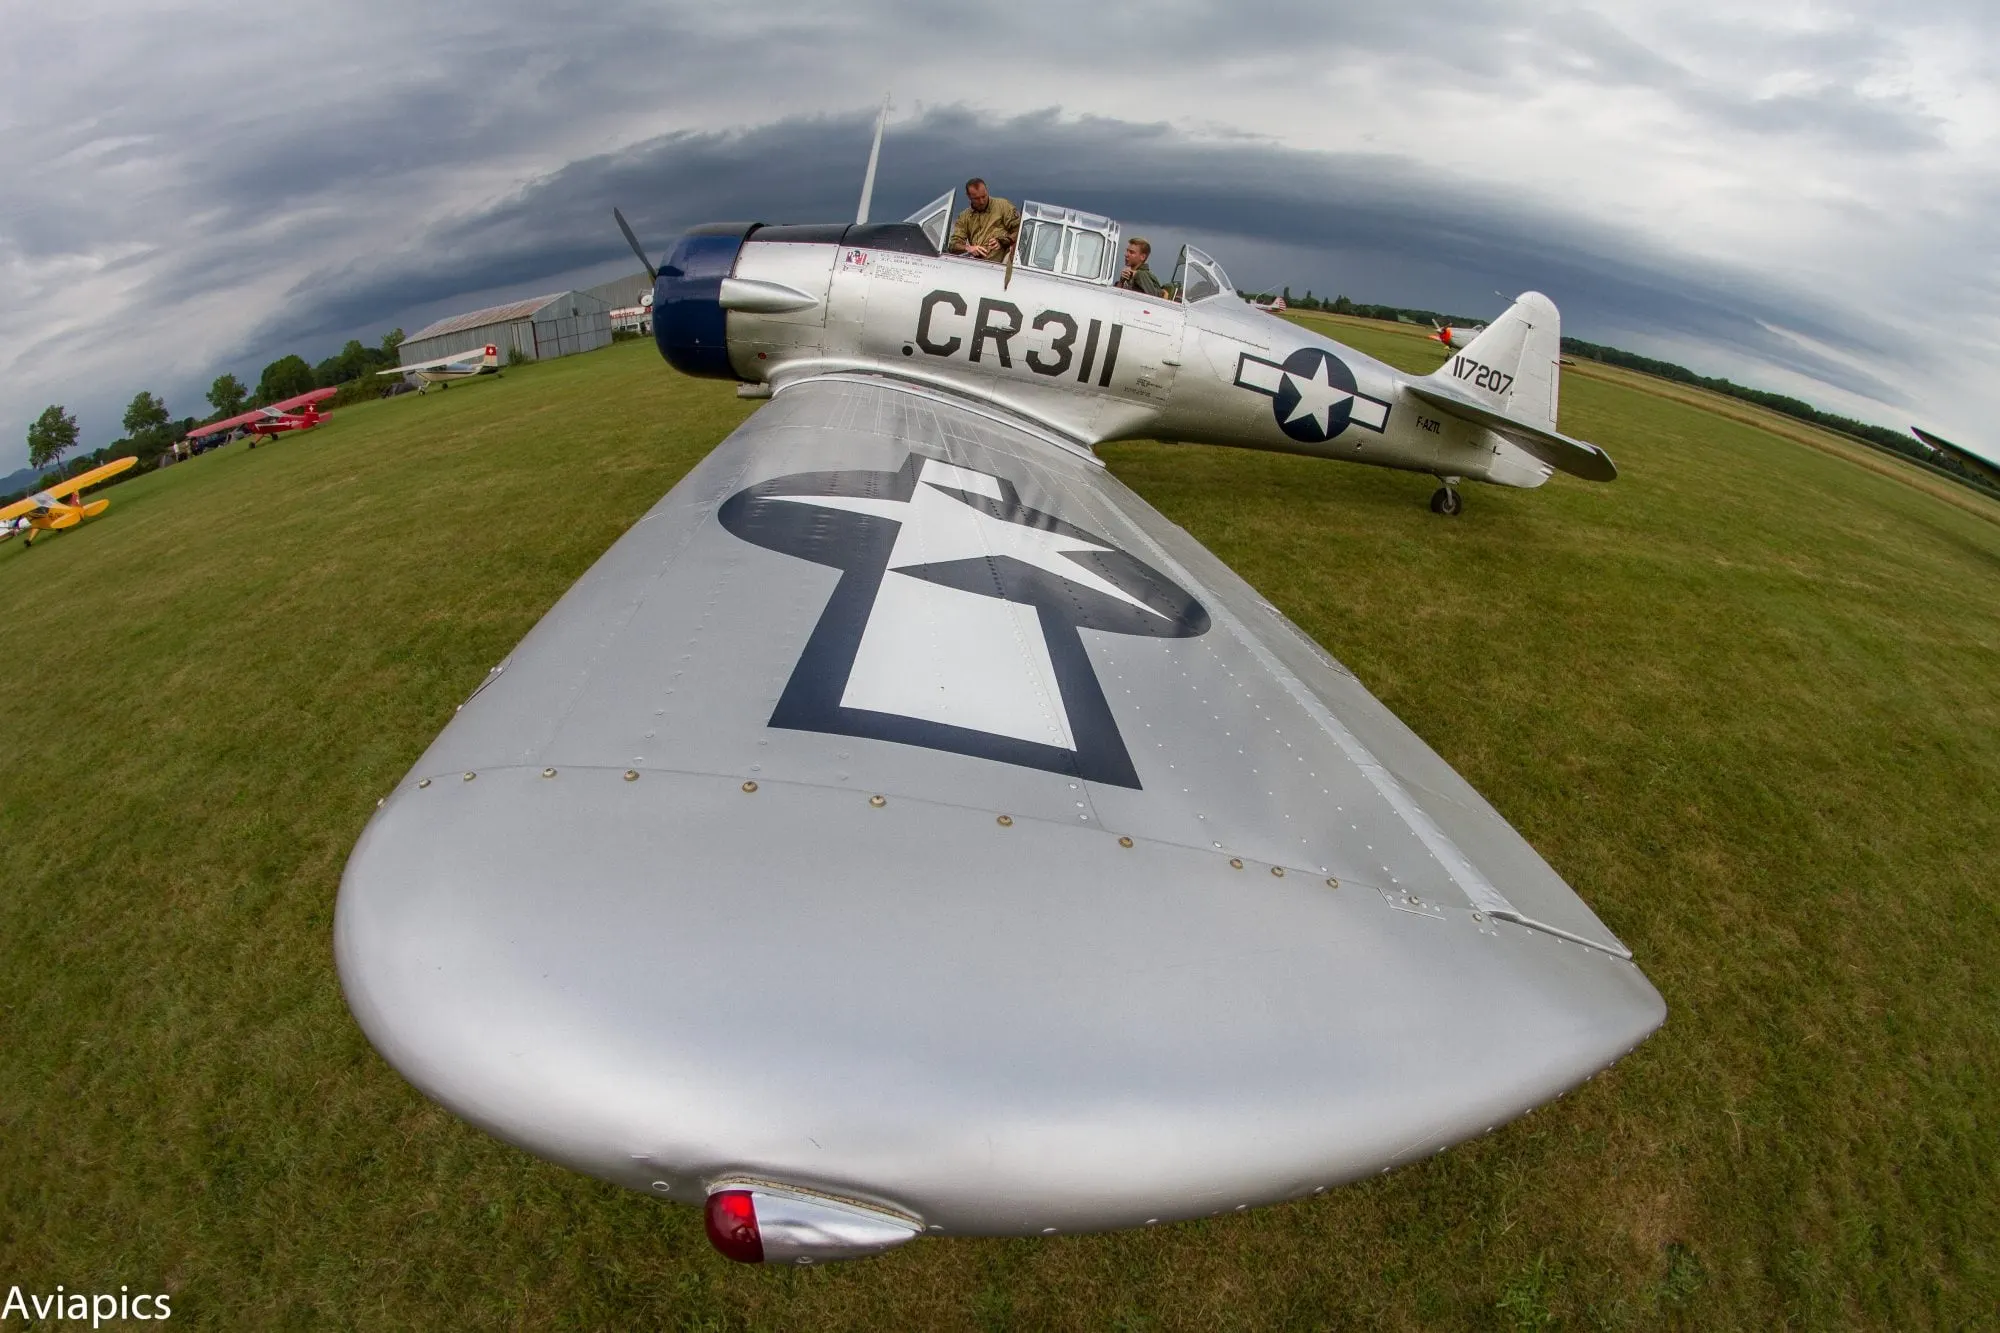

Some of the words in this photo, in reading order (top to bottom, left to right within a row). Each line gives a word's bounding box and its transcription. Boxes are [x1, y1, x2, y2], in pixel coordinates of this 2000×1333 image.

[915, 289, 1123, 388] CR311
[1453, 355, 1513, 395] 117207
[1416, 416, 1440, 434] F-AZTL
